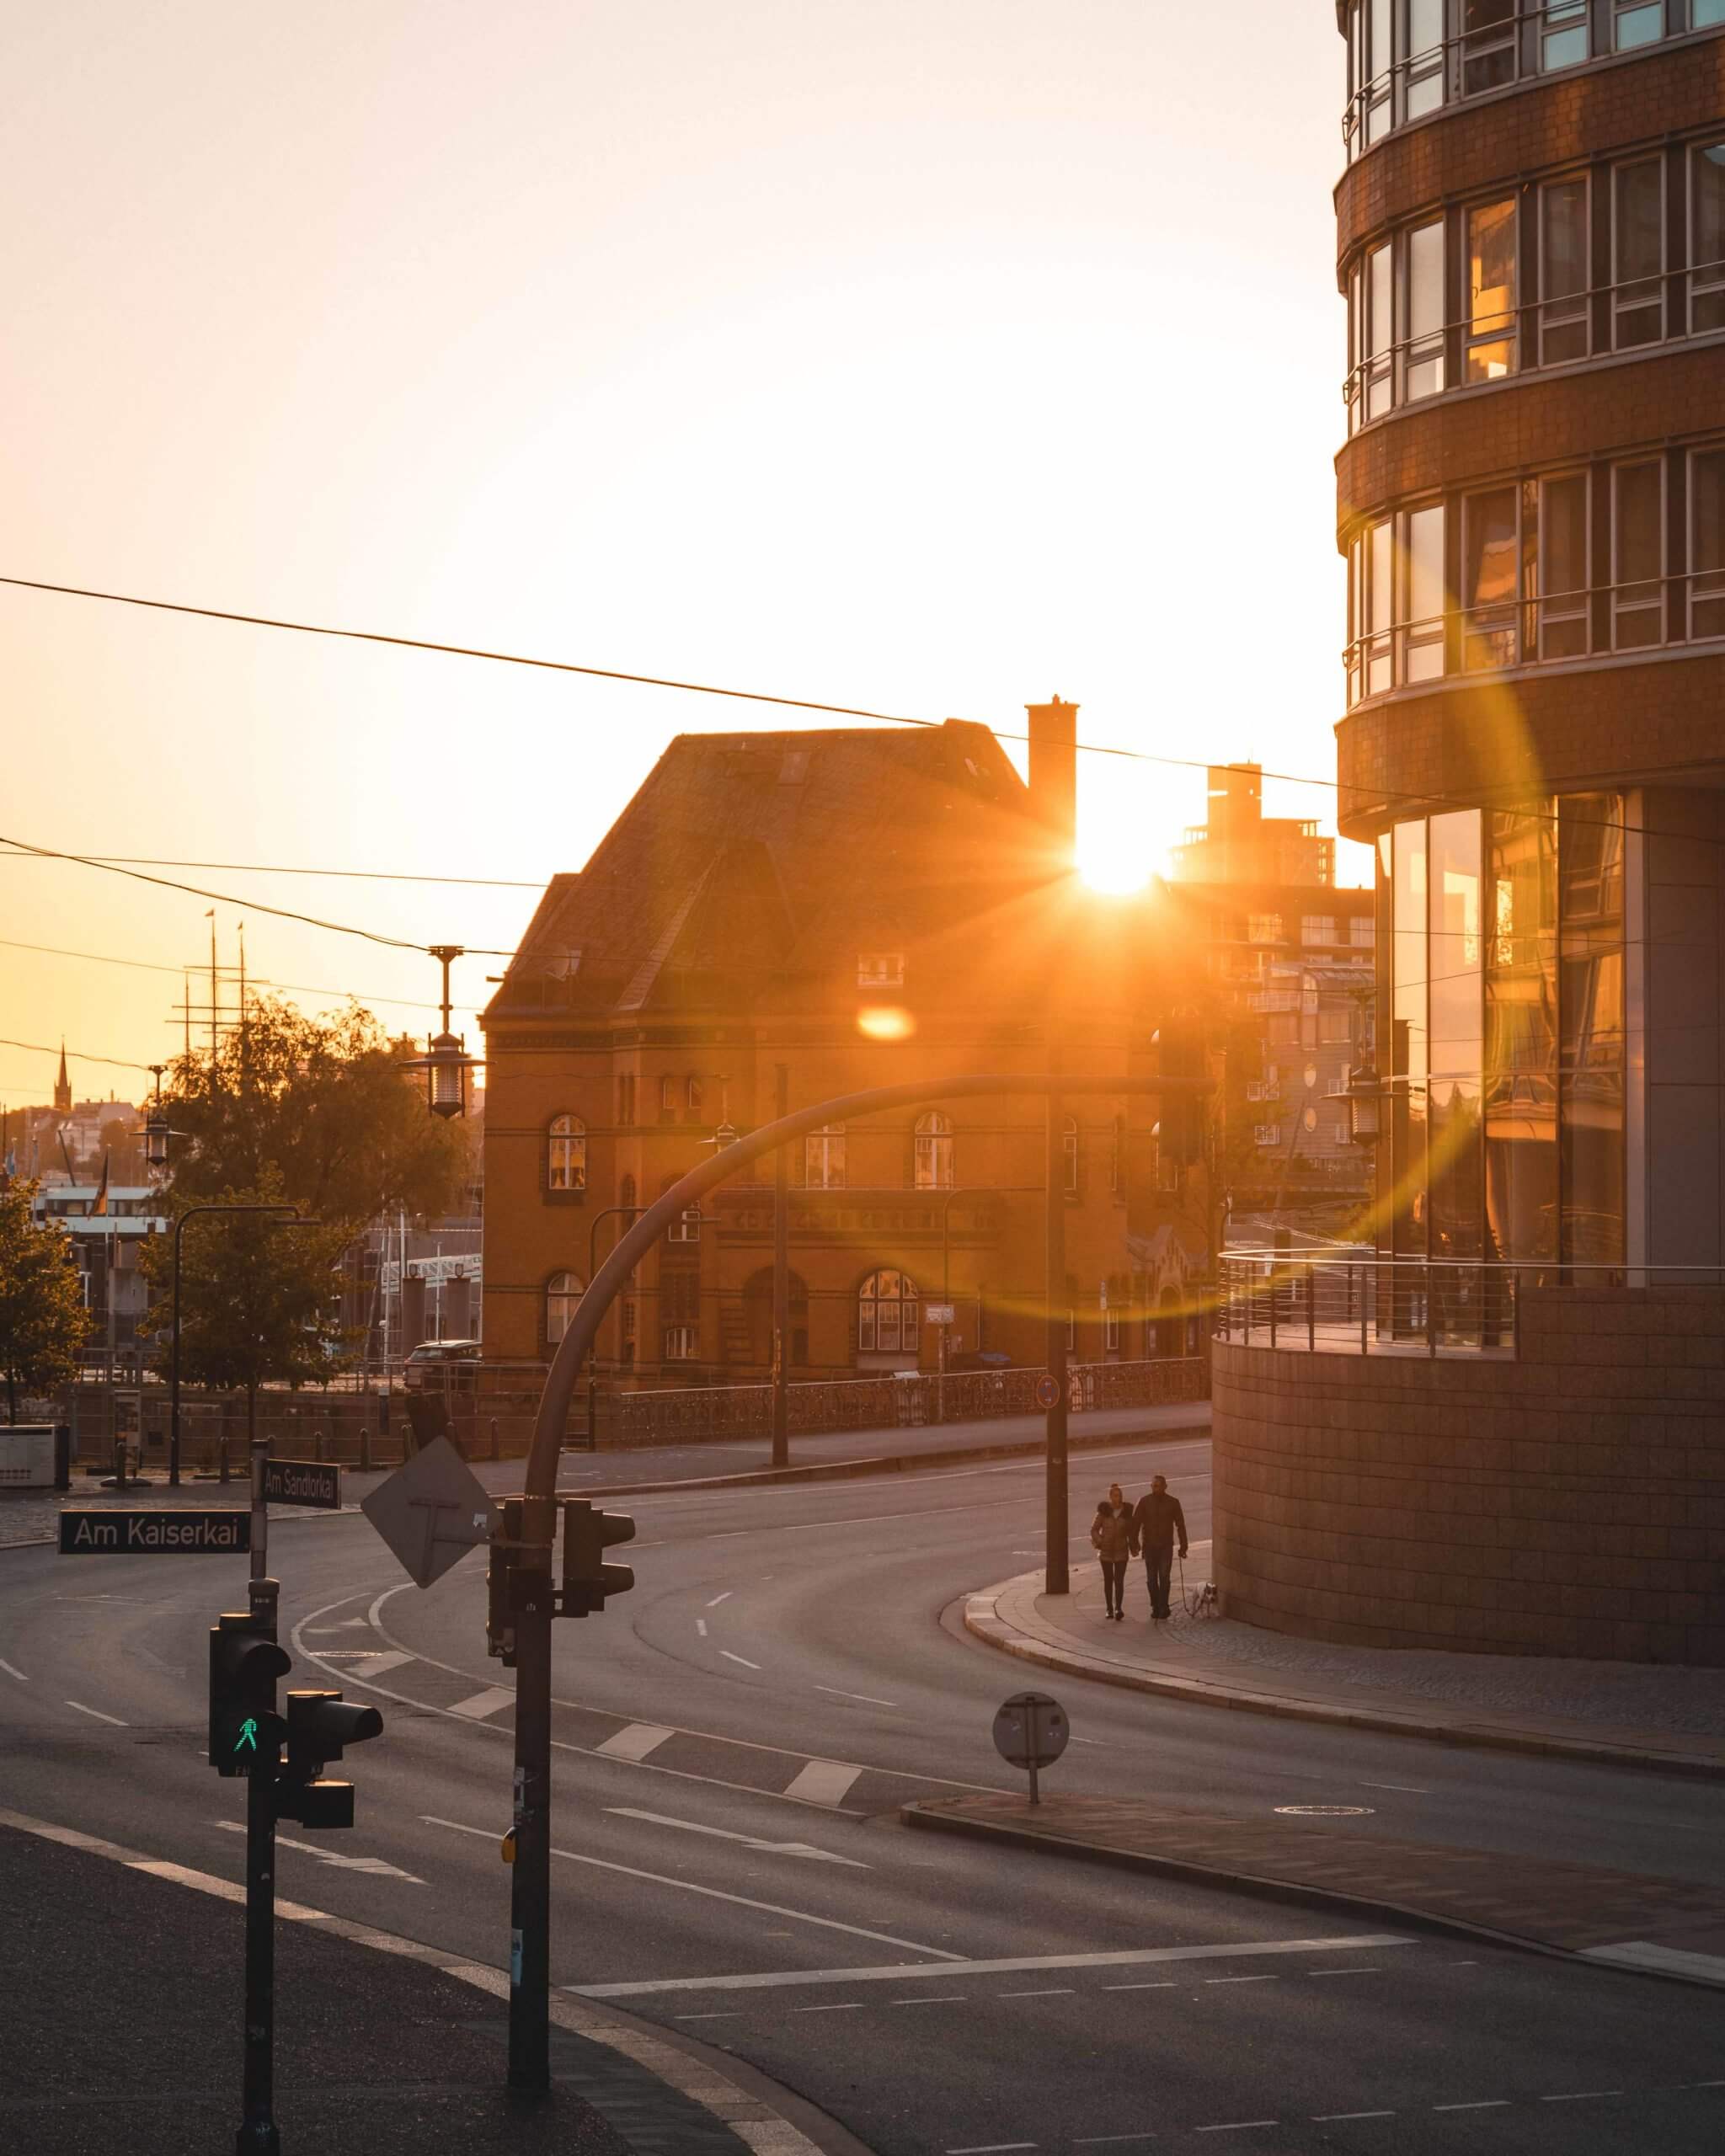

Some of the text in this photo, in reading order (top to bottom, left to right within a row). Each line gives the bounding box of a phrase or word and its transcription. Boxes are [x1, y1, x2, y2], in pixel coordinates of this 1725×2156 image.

[264, 1467, 281, 1494] Am
[74, 1518, 238, 1545] Am Kaiserkai
